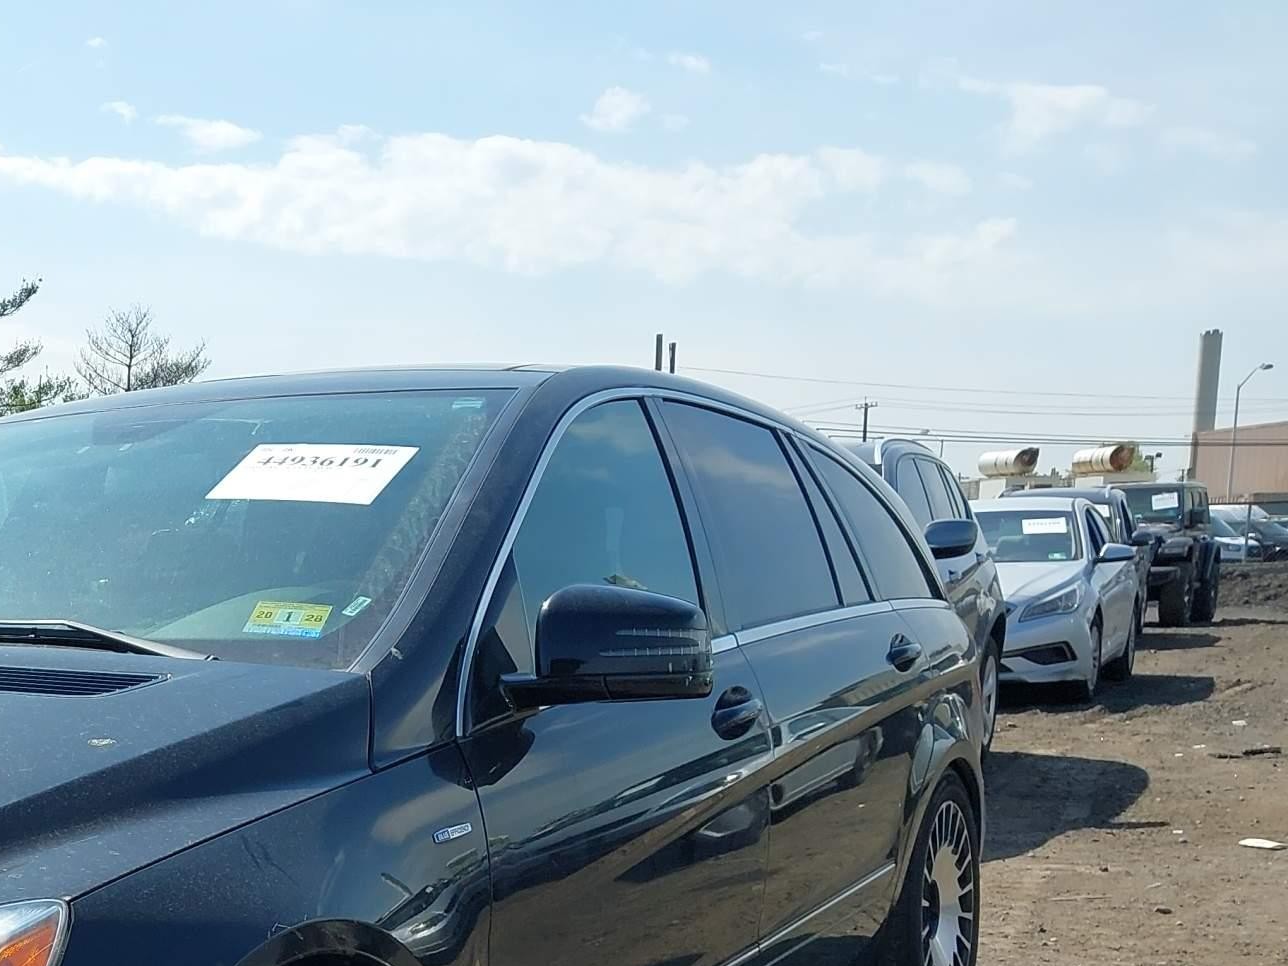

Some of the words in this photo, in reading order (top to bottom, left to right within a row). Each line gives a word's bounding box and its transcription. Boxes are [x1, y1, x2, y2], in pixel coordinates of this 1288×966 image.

[257, 455, 383, 468] 44936191
[256, 611, 273, 619] 20
[284, 611, 294, 622] 1
[304, 614, 323, 623] 28
